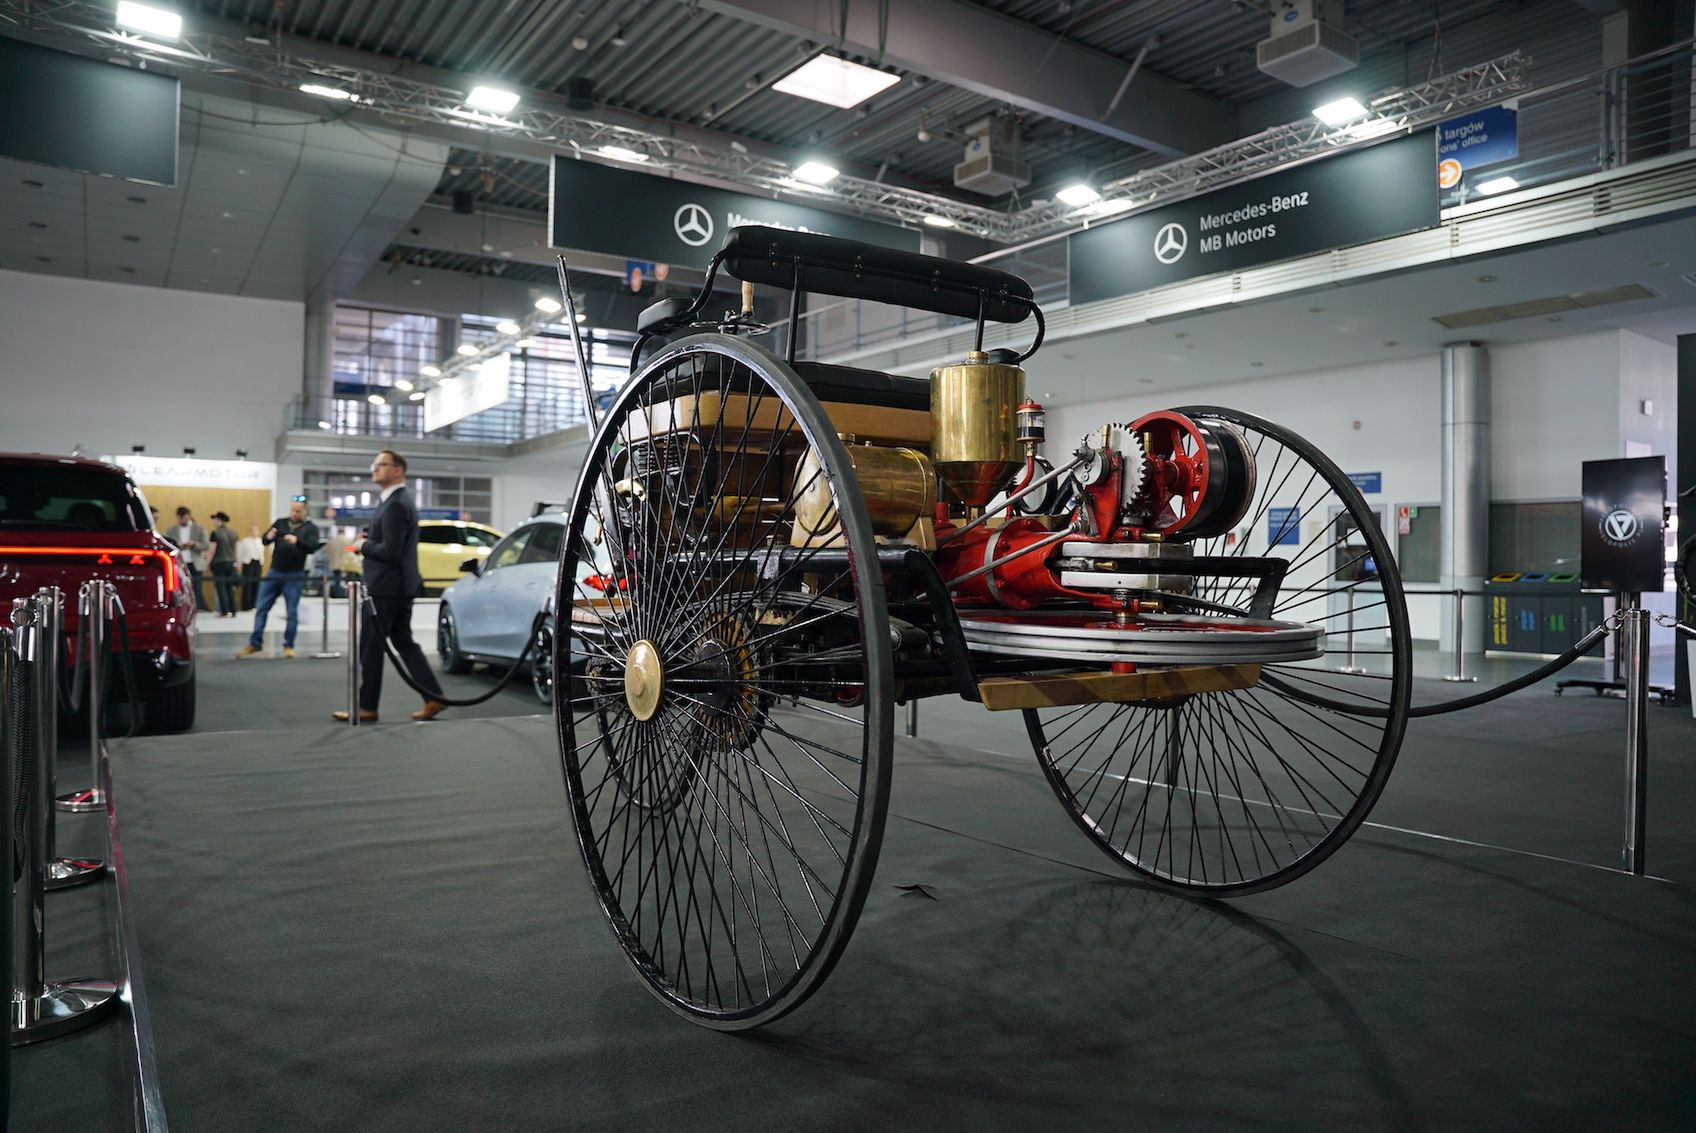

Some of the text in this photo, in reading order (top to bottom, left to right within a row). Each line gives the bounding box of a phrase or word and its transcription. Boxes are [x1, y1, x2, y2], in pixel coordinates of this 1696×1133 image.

[1444, 121, 1485, 140] targów
[1461, 134, 1489, 148] office
[1200, 191, 1309, 231] Mercedes-Benz
[1200, 223, 1277, 254] MB Motors
